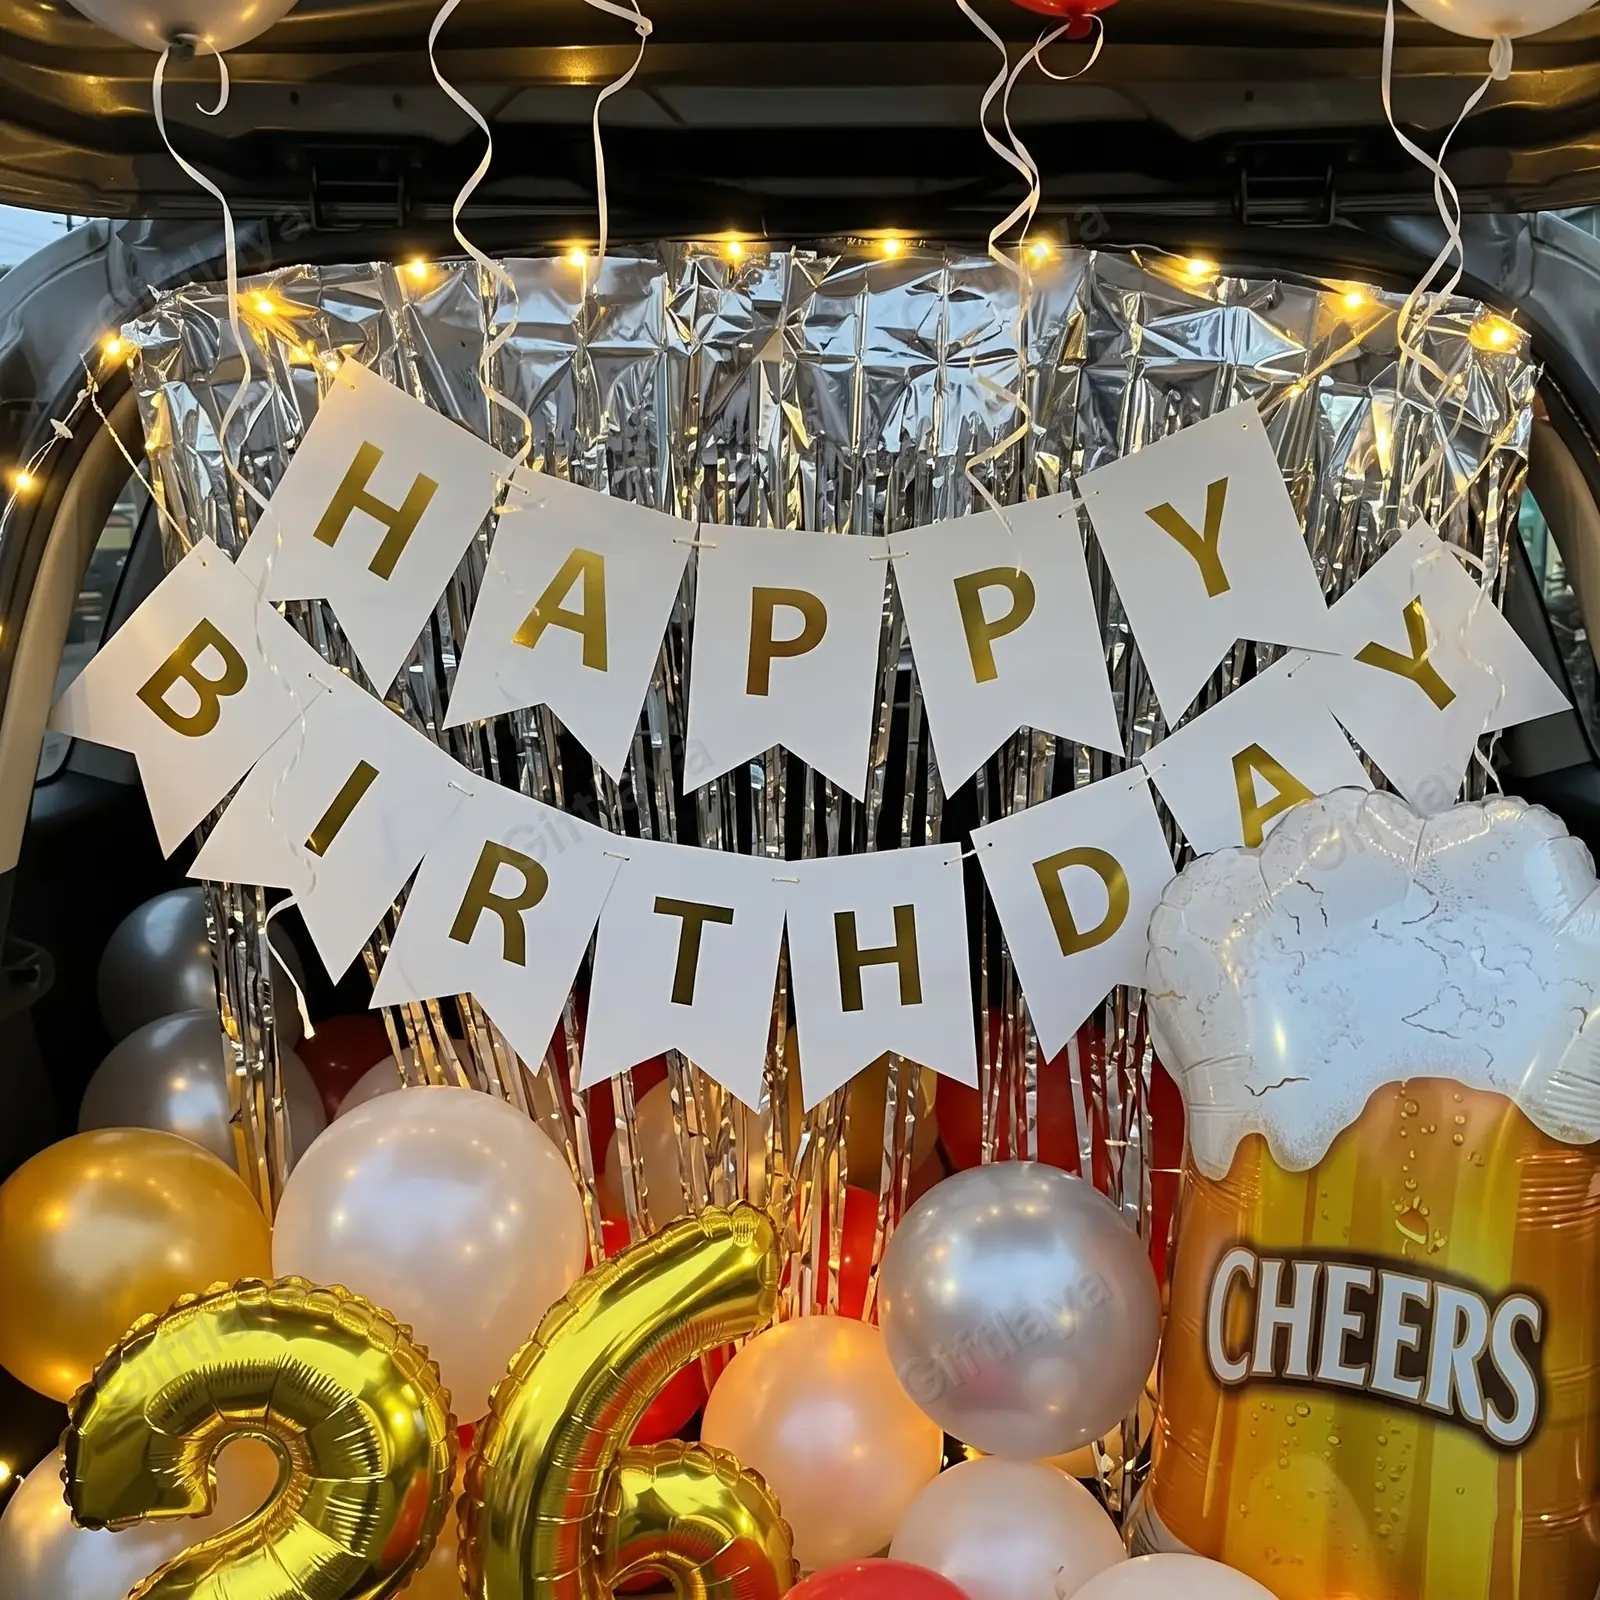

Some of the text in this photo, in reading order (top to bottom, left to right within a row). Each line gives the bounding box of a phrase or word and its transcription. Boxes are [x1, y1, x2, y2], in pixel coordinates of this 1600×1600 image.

[313, 440, 1230, 696] HAPPY
[136, 593, 1457, 1012] BIRTHDAY
[1206, 1246, 1542, 1447] CHEERS
